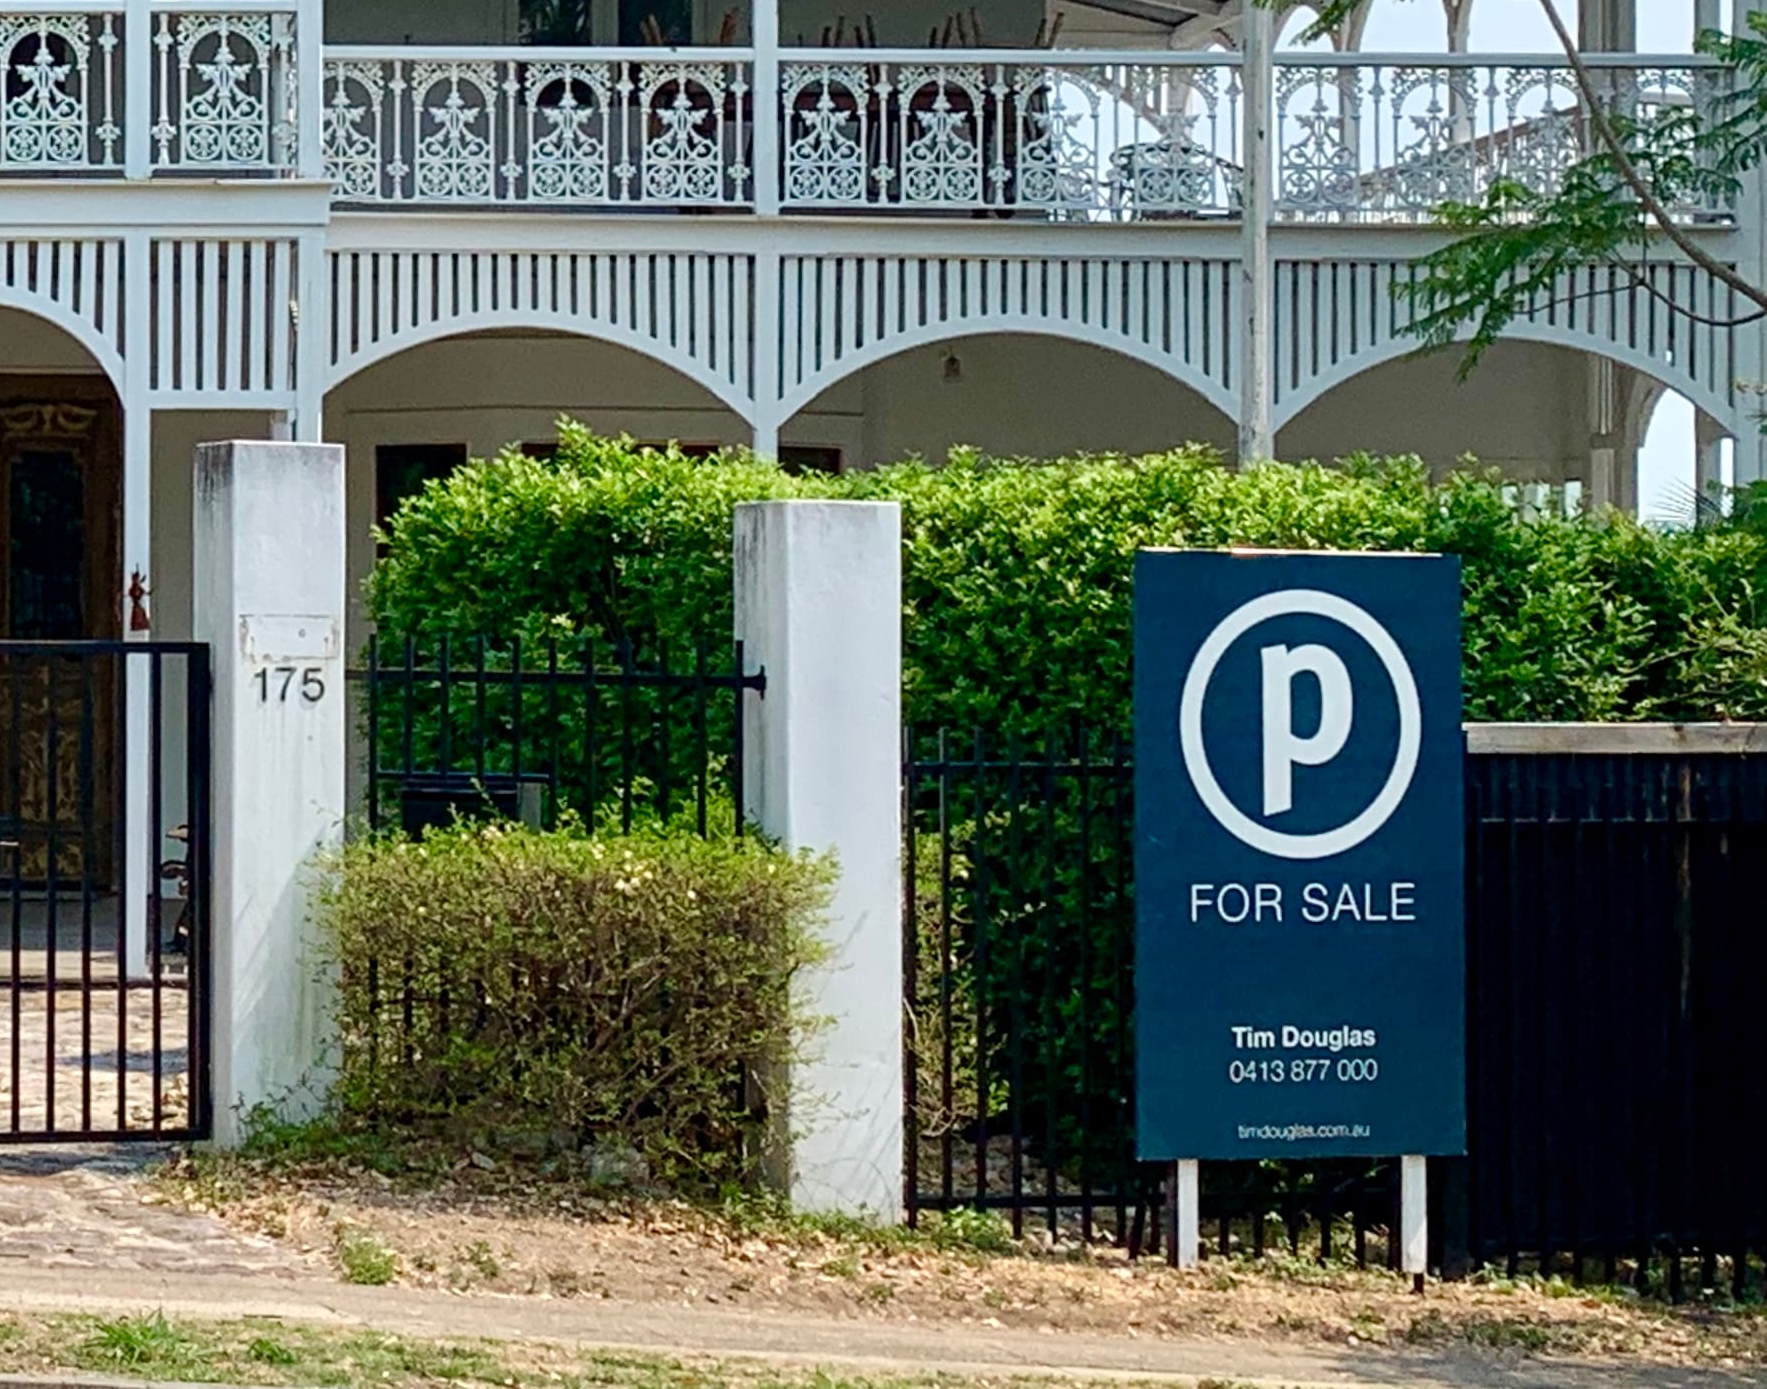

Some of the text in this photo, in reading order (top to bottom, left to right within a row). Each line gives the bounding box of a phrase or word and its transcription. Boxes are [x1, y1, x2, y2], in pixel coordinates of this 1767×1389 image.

[254, 667, 325, 702] 175
[1191, 882, 1416, 923] FOR SALE
[1231, 1025, 1376, 1052] Tim Douglas
[1229, 1058, 1378, 1084] 0413 877 000
[1238, 1123, 1370, 1141] timdouglas.com.au
